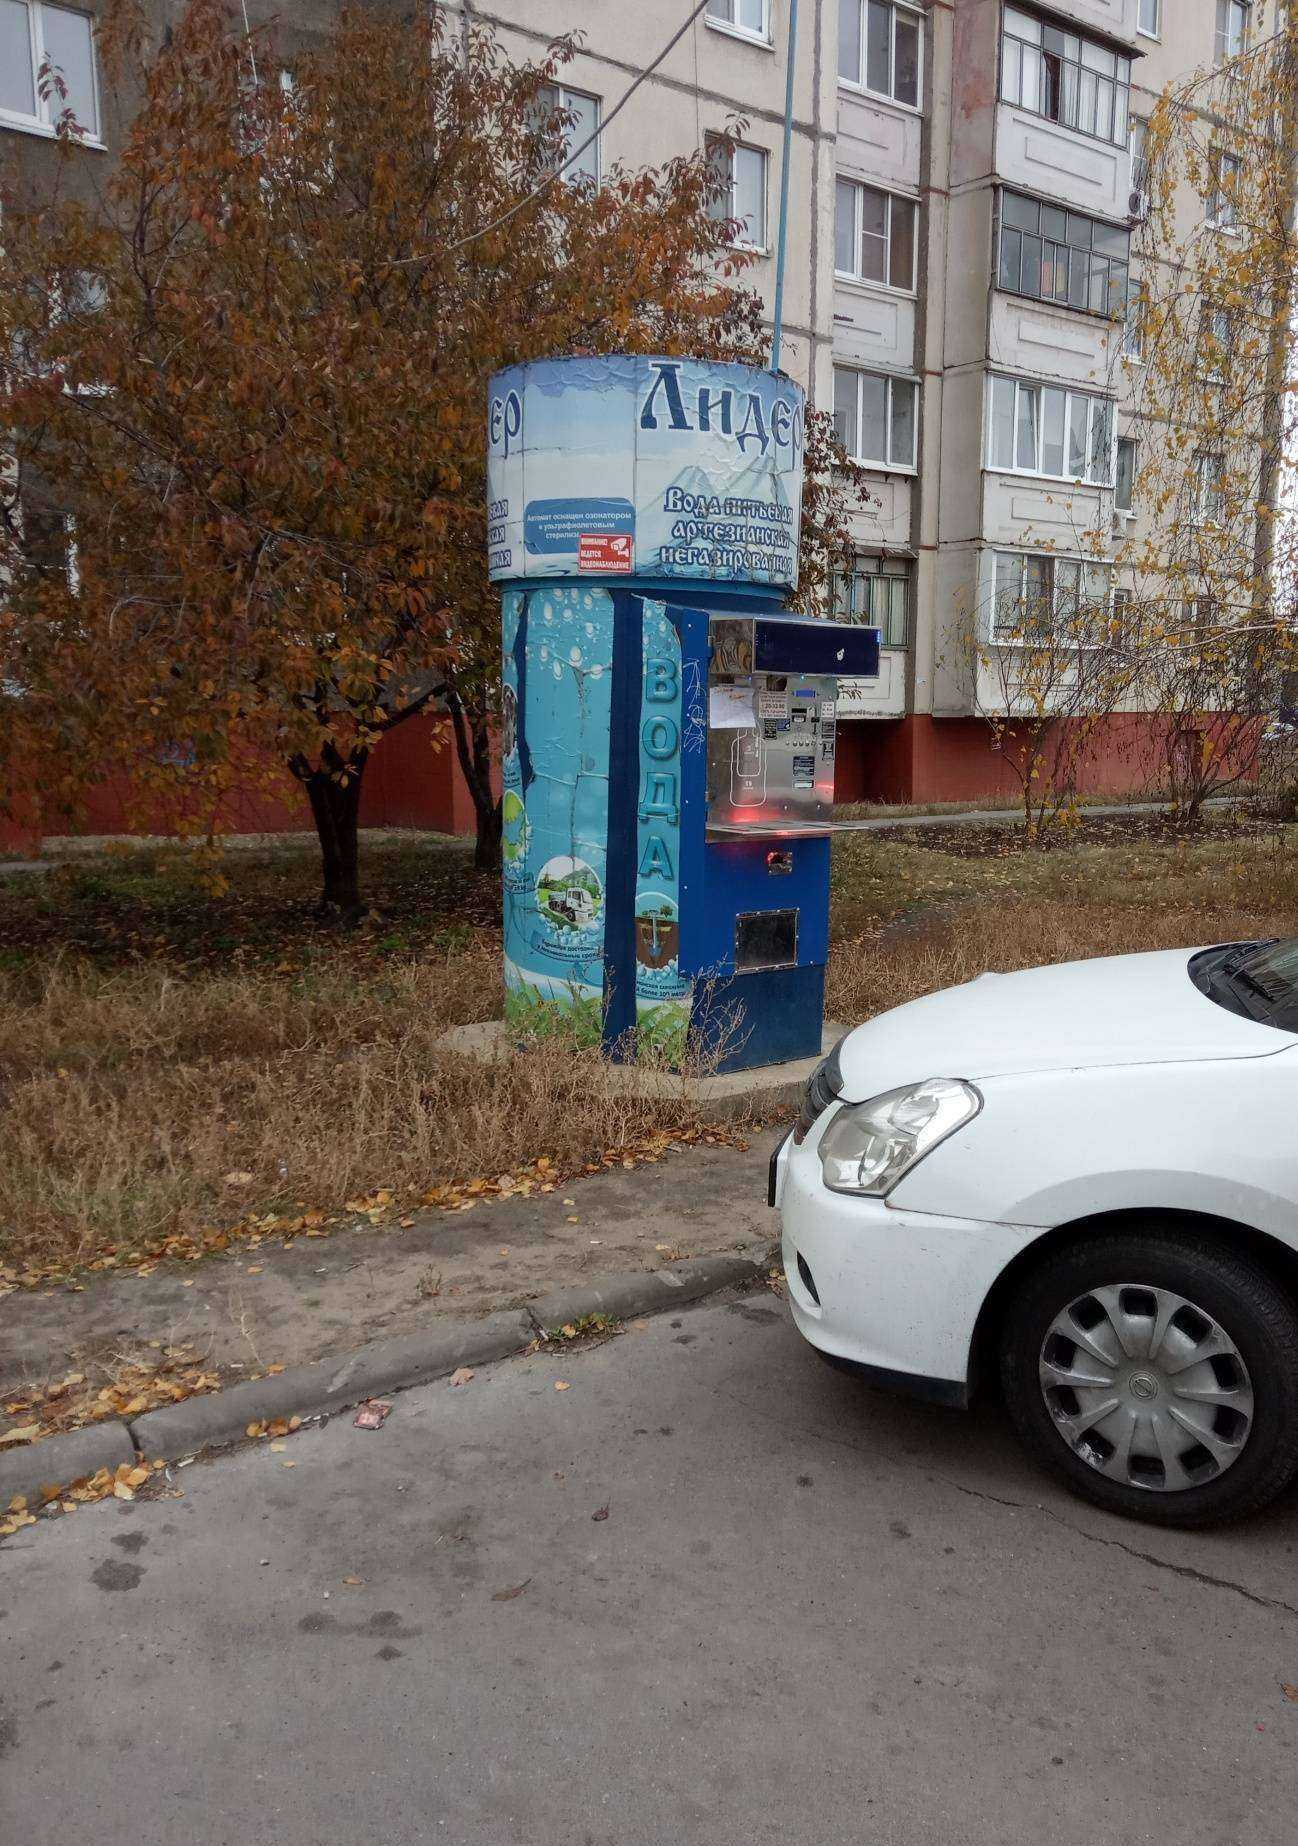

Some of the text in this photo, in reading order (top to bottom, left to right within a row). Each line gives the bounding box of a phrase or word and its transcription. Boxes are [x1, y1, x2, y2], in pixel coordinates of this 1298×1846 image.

[640, 361, 802, 471] Лидер
[552, 513, 584, 522] оснащен
[585, 512, 632, 521] озонатором
[663, 486, 793, 525] Вода питьевая
[544, 522, 616, 532] ультрафиолетовым
[672, 520, 791, 549] артезианская
[580, 560, 630, 570] ВИДЕОНАБЛЮДЕНИЕ
[660, 545, 792, 575] негазированная
[637, 657, 682, 881] ВОДА
